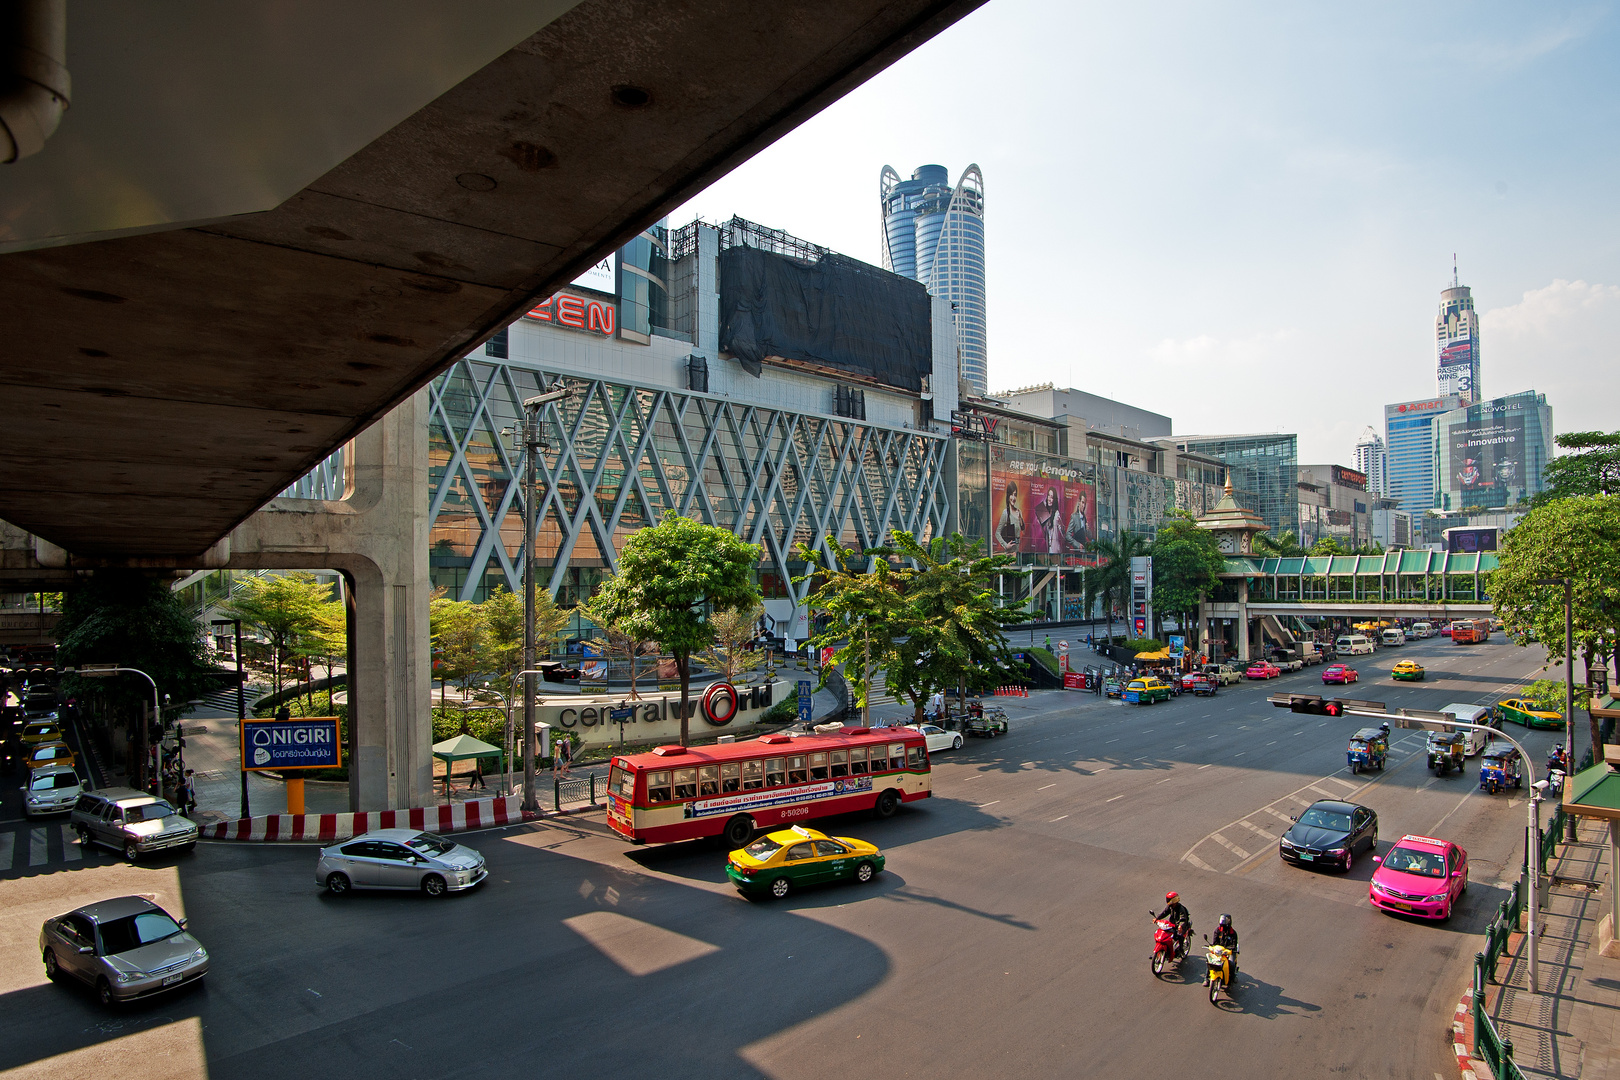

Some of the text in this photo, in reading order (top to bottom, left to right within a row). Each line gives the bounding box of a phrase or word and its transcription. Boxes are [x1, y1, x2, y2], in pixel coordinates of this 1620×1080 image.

[587, 270, 612, 280] OMENTS
[1458, 376, 1471, 391] 3
[1408, 399, 1443, 412] Amari
[1481, 402, 1523, 414] NOVOTEL
[1467, 435, 1515, 447] Innovative
[1009, 460, 1024, 470] ARE
[1026, 462, 1038, 472] YOU
[1041, 462, 1077, 478] lenovo
[1085, 678, 1091, 688] 3
[253, 727, 330, 746] ONIGIRI
[781, 806, 809, 818] 8-50206
